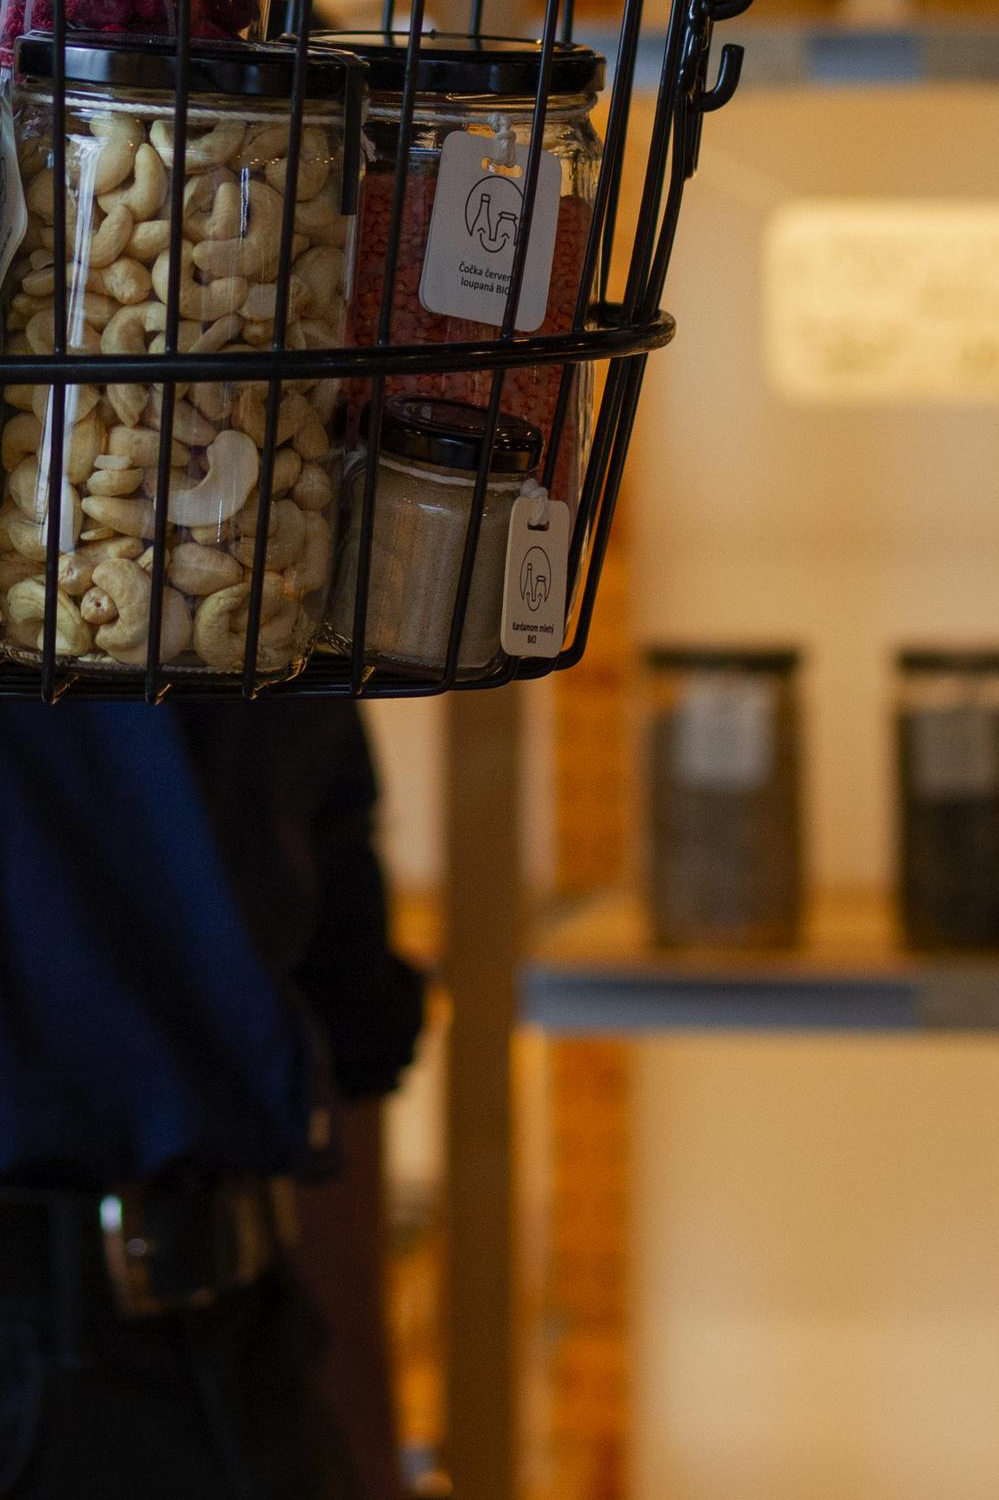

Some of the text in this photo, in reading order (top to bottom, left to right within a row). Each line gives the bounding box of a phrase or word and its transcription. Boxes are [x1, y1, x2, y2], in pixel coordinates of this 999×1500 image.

[458, 260, 512, 282] Čočka červen
[460, 276, 494, 293] loupaná
[527, 634, 537, 644] BIO
